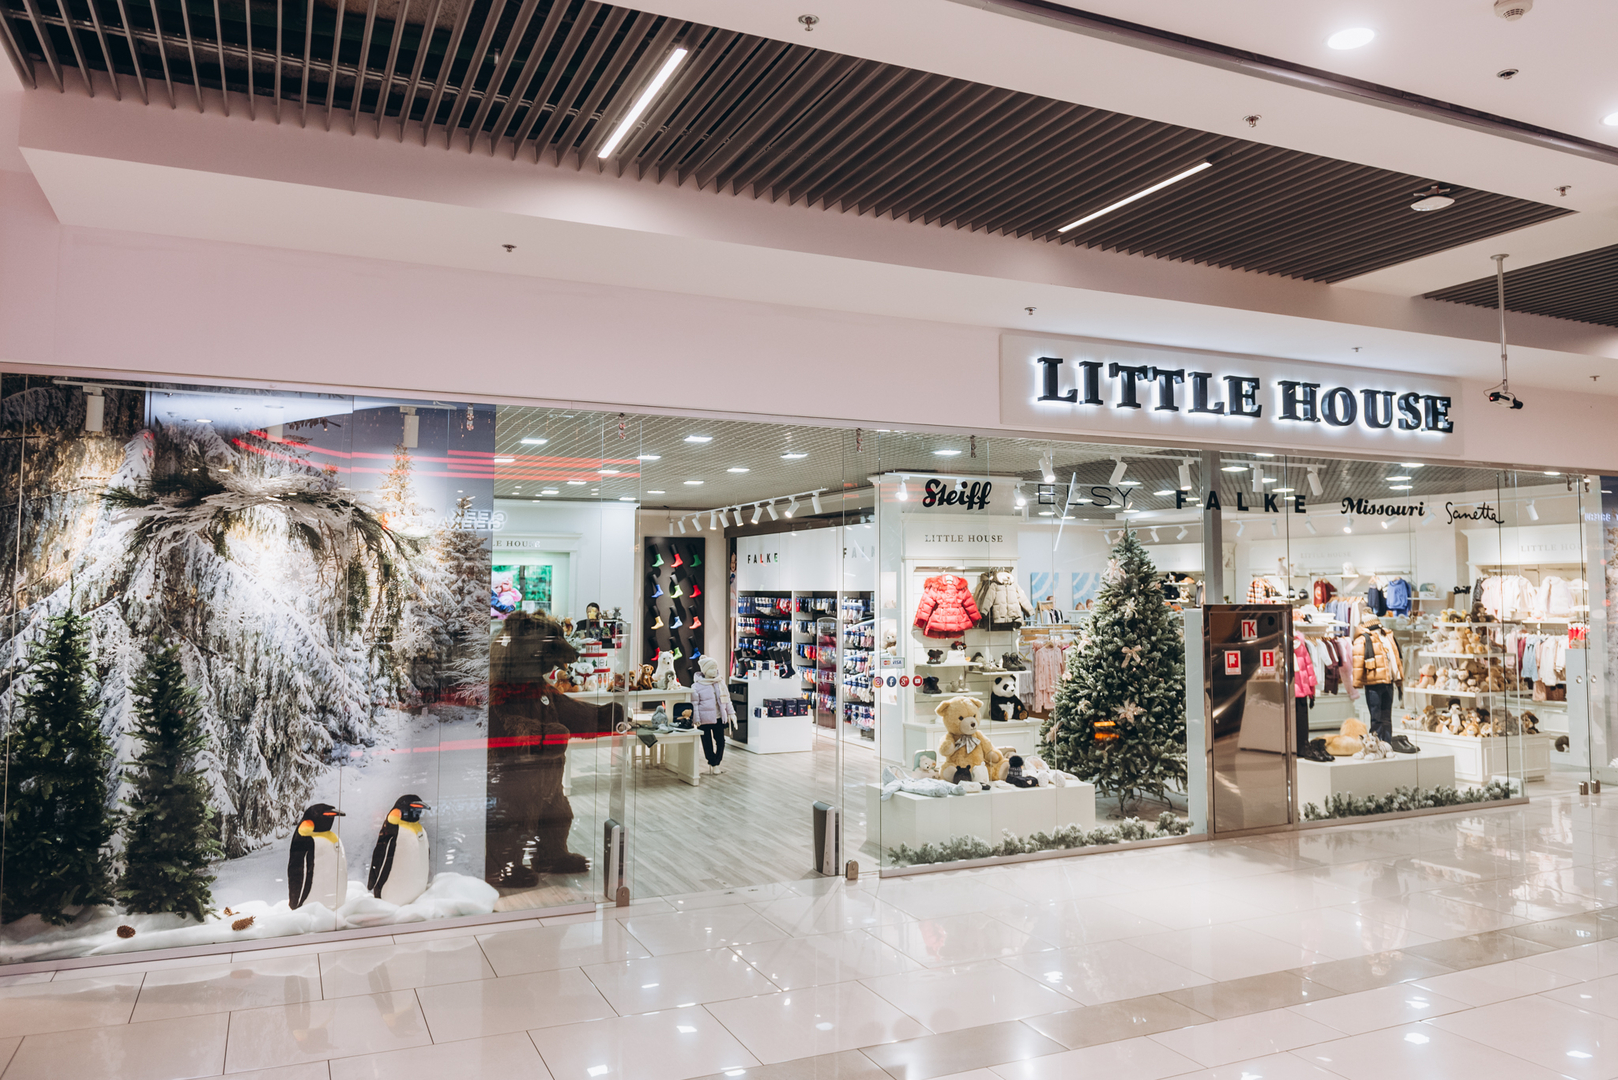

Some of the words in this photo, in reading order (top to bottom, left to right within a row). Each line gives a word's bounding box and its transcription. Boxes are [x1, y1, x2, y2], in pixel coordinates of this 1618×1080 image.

[1036, 355, 1262, 418] LITTLE
[1277, 379, 1455, 434] HOUSE
[922, 478, 992, 510] Steiff
[1037, 483, 1133, 508] ELSY
[1175, 489, 1307, 514] FALKE
[1340, 496, 1425, 517] Missouri
[1444, 501, 1505, 525] Sanette
[924, 534, 964, 543] LITTLE
[967, 534, 1004, 543] HOUSE
[747, 552, 778, 564] FALKE
[1242, 621, 1256, 638] ПК
